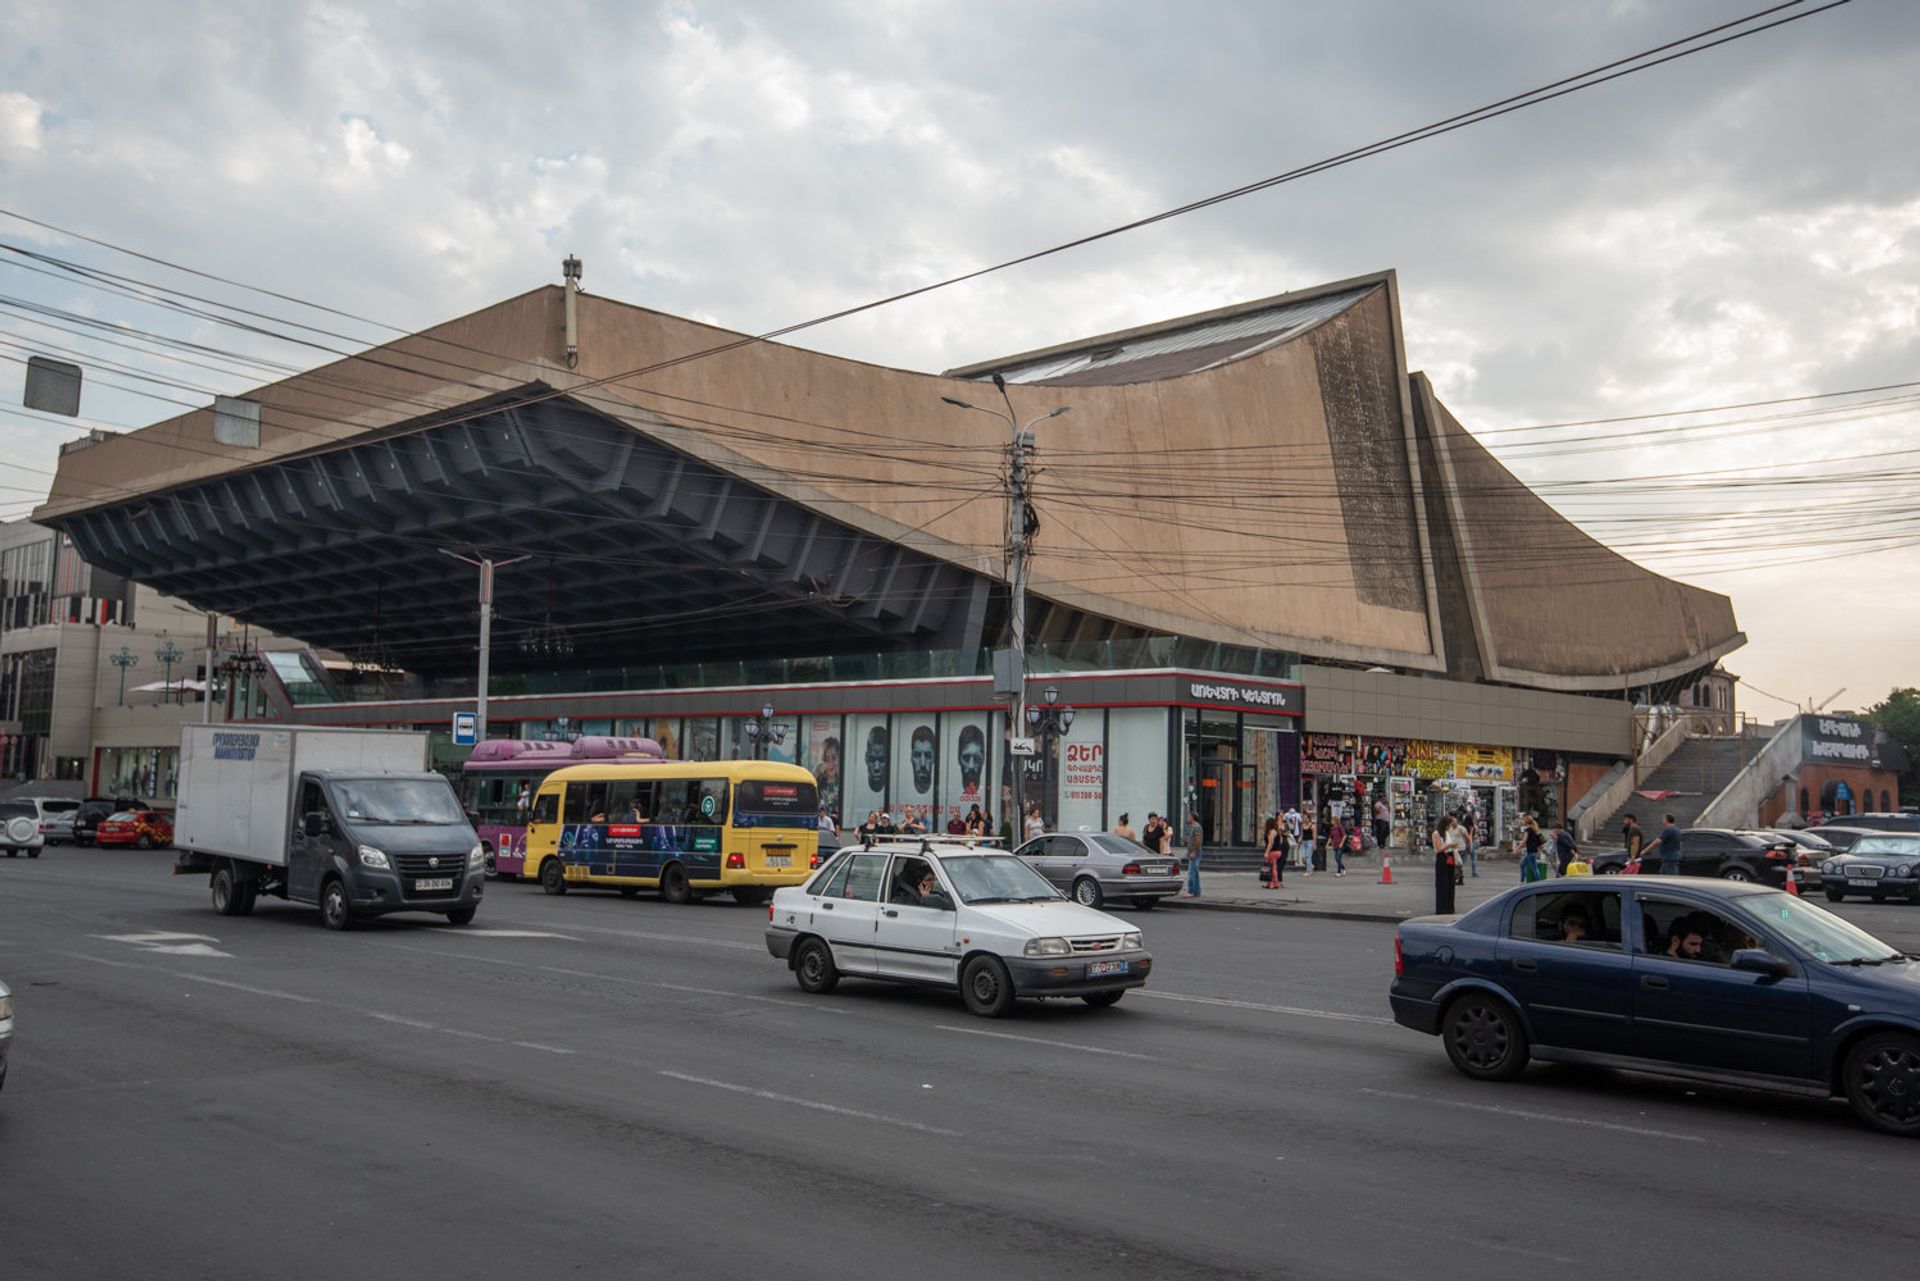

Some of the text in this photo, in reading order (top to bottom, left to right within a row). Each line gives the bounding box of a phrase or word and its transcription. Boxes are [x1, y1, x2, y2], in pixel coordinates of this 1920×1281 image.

[1191, 683, 1286, 706] ԱՌԵՎՏՐԻ ԿԵՆՏՐՈՆ
[1067, 744, 1103, 762] ՁԵՐ
